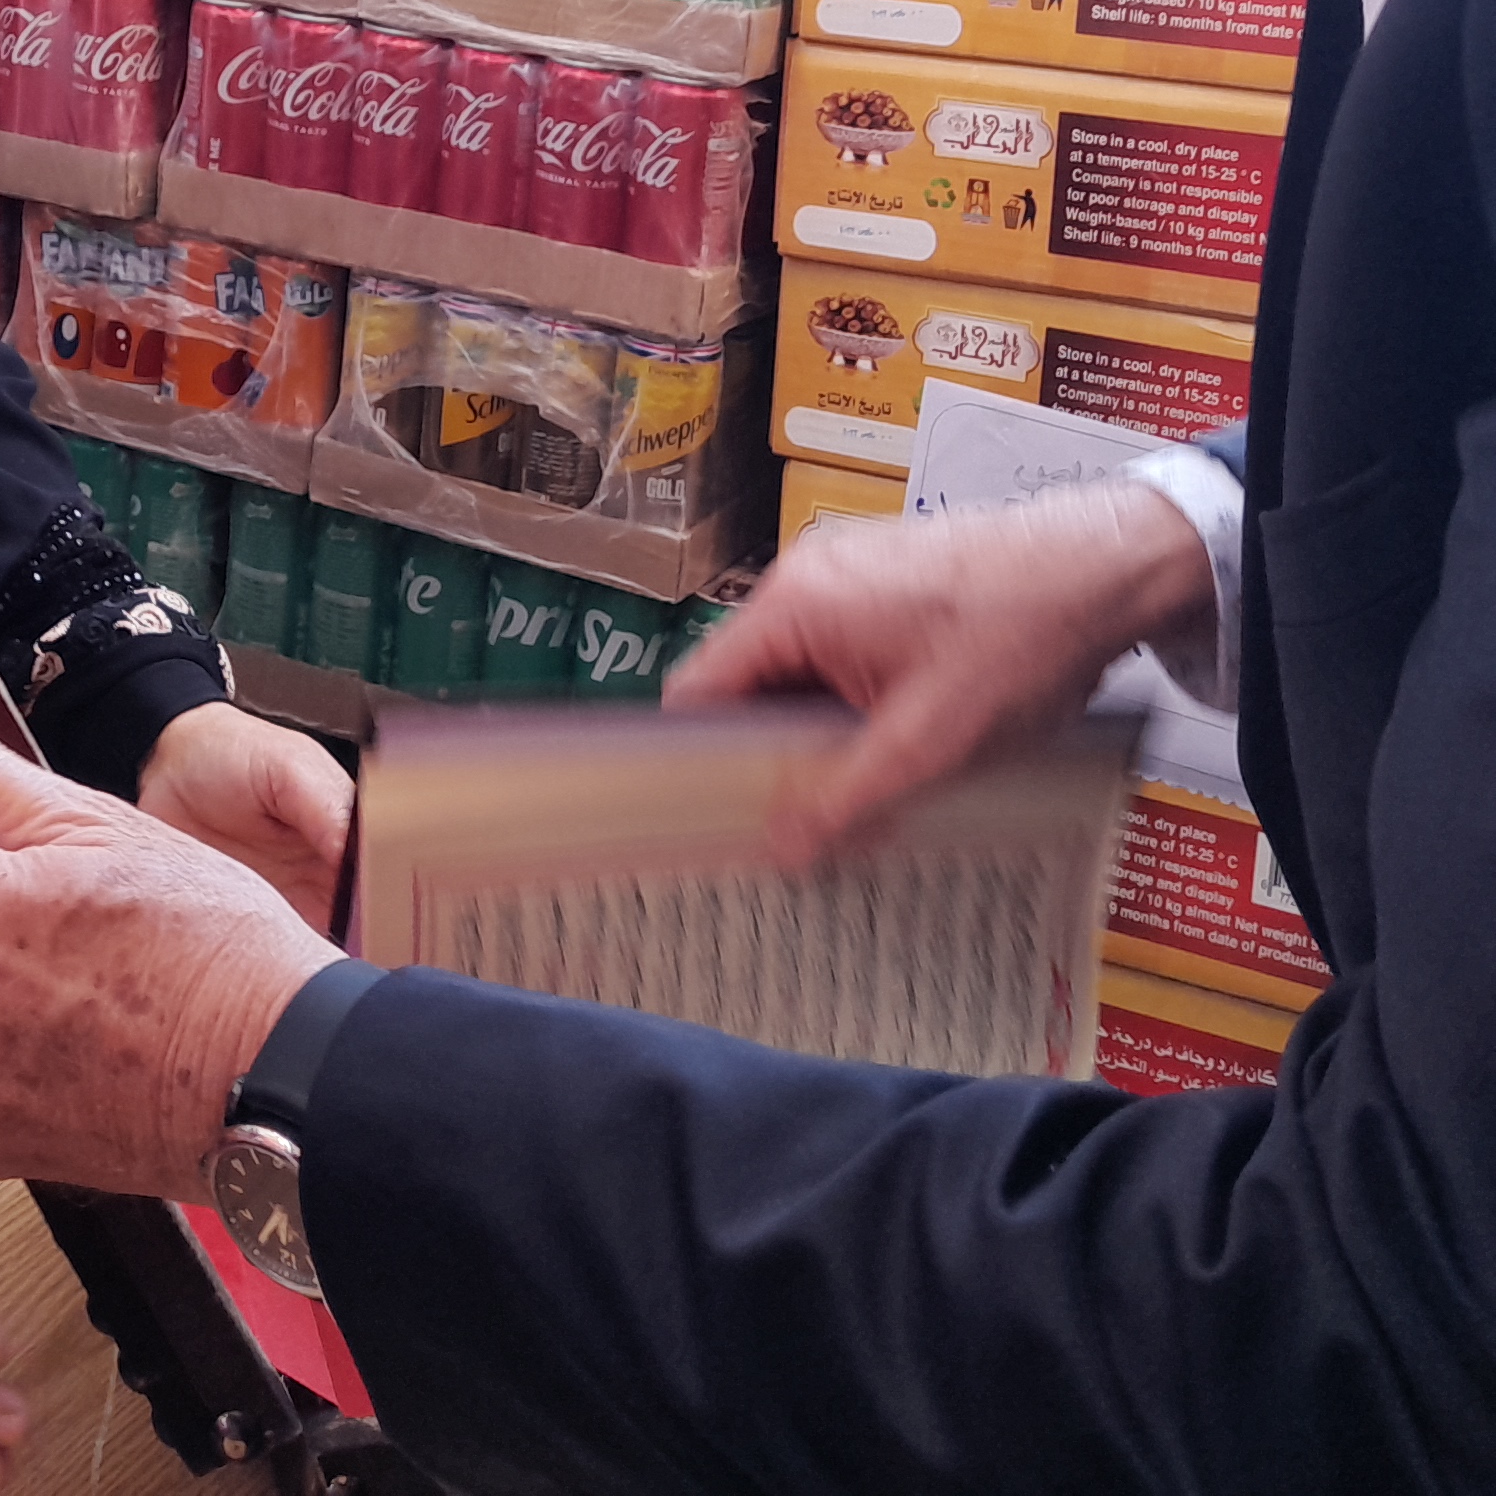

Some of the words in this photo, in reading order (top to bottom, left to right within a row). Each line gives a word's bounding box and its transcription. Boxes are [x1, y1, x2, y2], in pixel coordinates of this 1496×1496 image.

[1092, 5, 1127, 21] Shelf
[1129, 10, 1155, 24] life:
[1158, 14, 1166, 25] 9
[1170, 14, 1222, 31] months
[1226, 19, 1259, 36] from
[1262, 23, 1294, 39] date
[1238, 0, 1287, 18] almost
[1071, 128, 1108, 145] Store
[1110, 133, 1124, 147] in
[1127, 139, 1135, 149] a
[1138, 139, 1171, 155] cool,
[1175, 142, 1198, 159] dry
[1201, 145, 1239, 162] place
[1070, 150, 1083, 163] at
[1086, 154, 1094, 164] a
[1098, 152, 1179, 175] temperature
[1182, 162, 1196, 175] of
[1201, 164, 1237, 181] 15-25
[1250, 171, 1262, 185] C
[1072, 168, 1136, 192] Company
[1139, 176, 1152, 191] is
[1154, 179, 1177, 194] not
[1181, 183, 1262, 205] responsible
[1066, 187, 1085, 201] for
[1089, 192, 1120, 207] poor
[1123, 195, 1175, 215] storage
[1178, 203, 1204, 217] and
[1207, 205, 1258, 228] display
[1065, 207, 1156, 231] Weight-based
[1169, 222, 1185, 235] 10
[1187, 222, 1204, 241] kg
[1208, 227, 1255, 245] almost
[1064, 226, 1097, 243] Shelf
[1101, 231, 1126, 248] life:
[1130, 235, 1137, 248] 9
[1141, 239, 1192, 256] months
[1196, 245, 1228, 261] from
[1232, 249, 1262, 266] date
[1058, 345, 1092, 363] Store
[1095, 351, 1108, 366] in
[1112, 357, 1120, 368] a
[1123, 357, 1155, 376] cool,
[1159, 364, 1181, 382] dry
[1185, 369, 1222, 386] place
[1056, 365, 1067, 378] at
[1071, 371, 1079, 380] a
[1083, 370, 1162, 396] temperature
[1165, 383, 1179, 398] of
[1184, 388, 1220, 406] 15-25
[1232, 396, 1244, 410] C
[1058, 384, 1120, 411] Company
[1123, 396, 1135, 410] is
[1138, 400, 1161, 414] not
[1161, 426, 1186, 441] and
[1109, 864, 1154, 886] torage
[1246, 1068, 1278, 1087] كان
